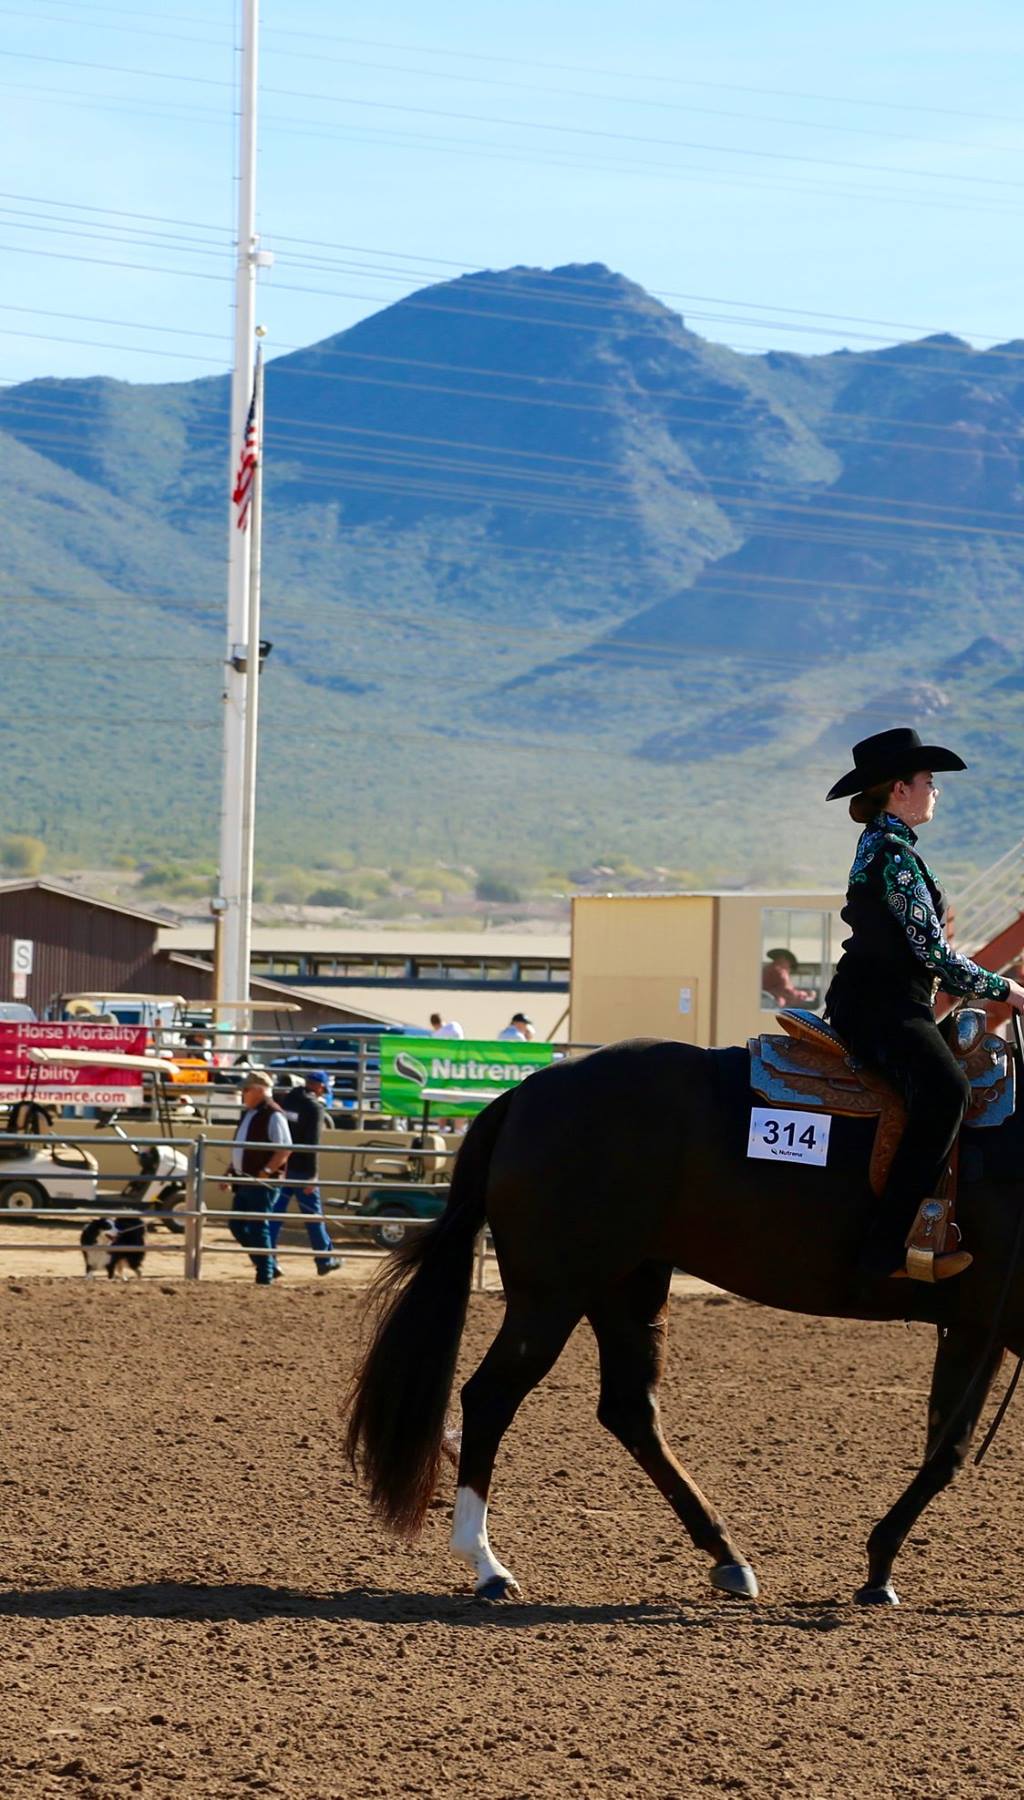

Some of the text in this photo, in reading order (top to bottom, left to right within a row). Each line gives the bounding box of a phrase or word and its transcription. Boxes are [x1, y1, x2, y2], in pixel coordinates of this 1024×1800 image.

[17, 1024, 140, 1044] Horse Mortality
[16, 1065, 79, 1083] Liability
[431, 1058, 537, 1082] Nutrena
[763, 1120, 817, 1150] 314
[779, 1149, 803, 1158] Nutrena
